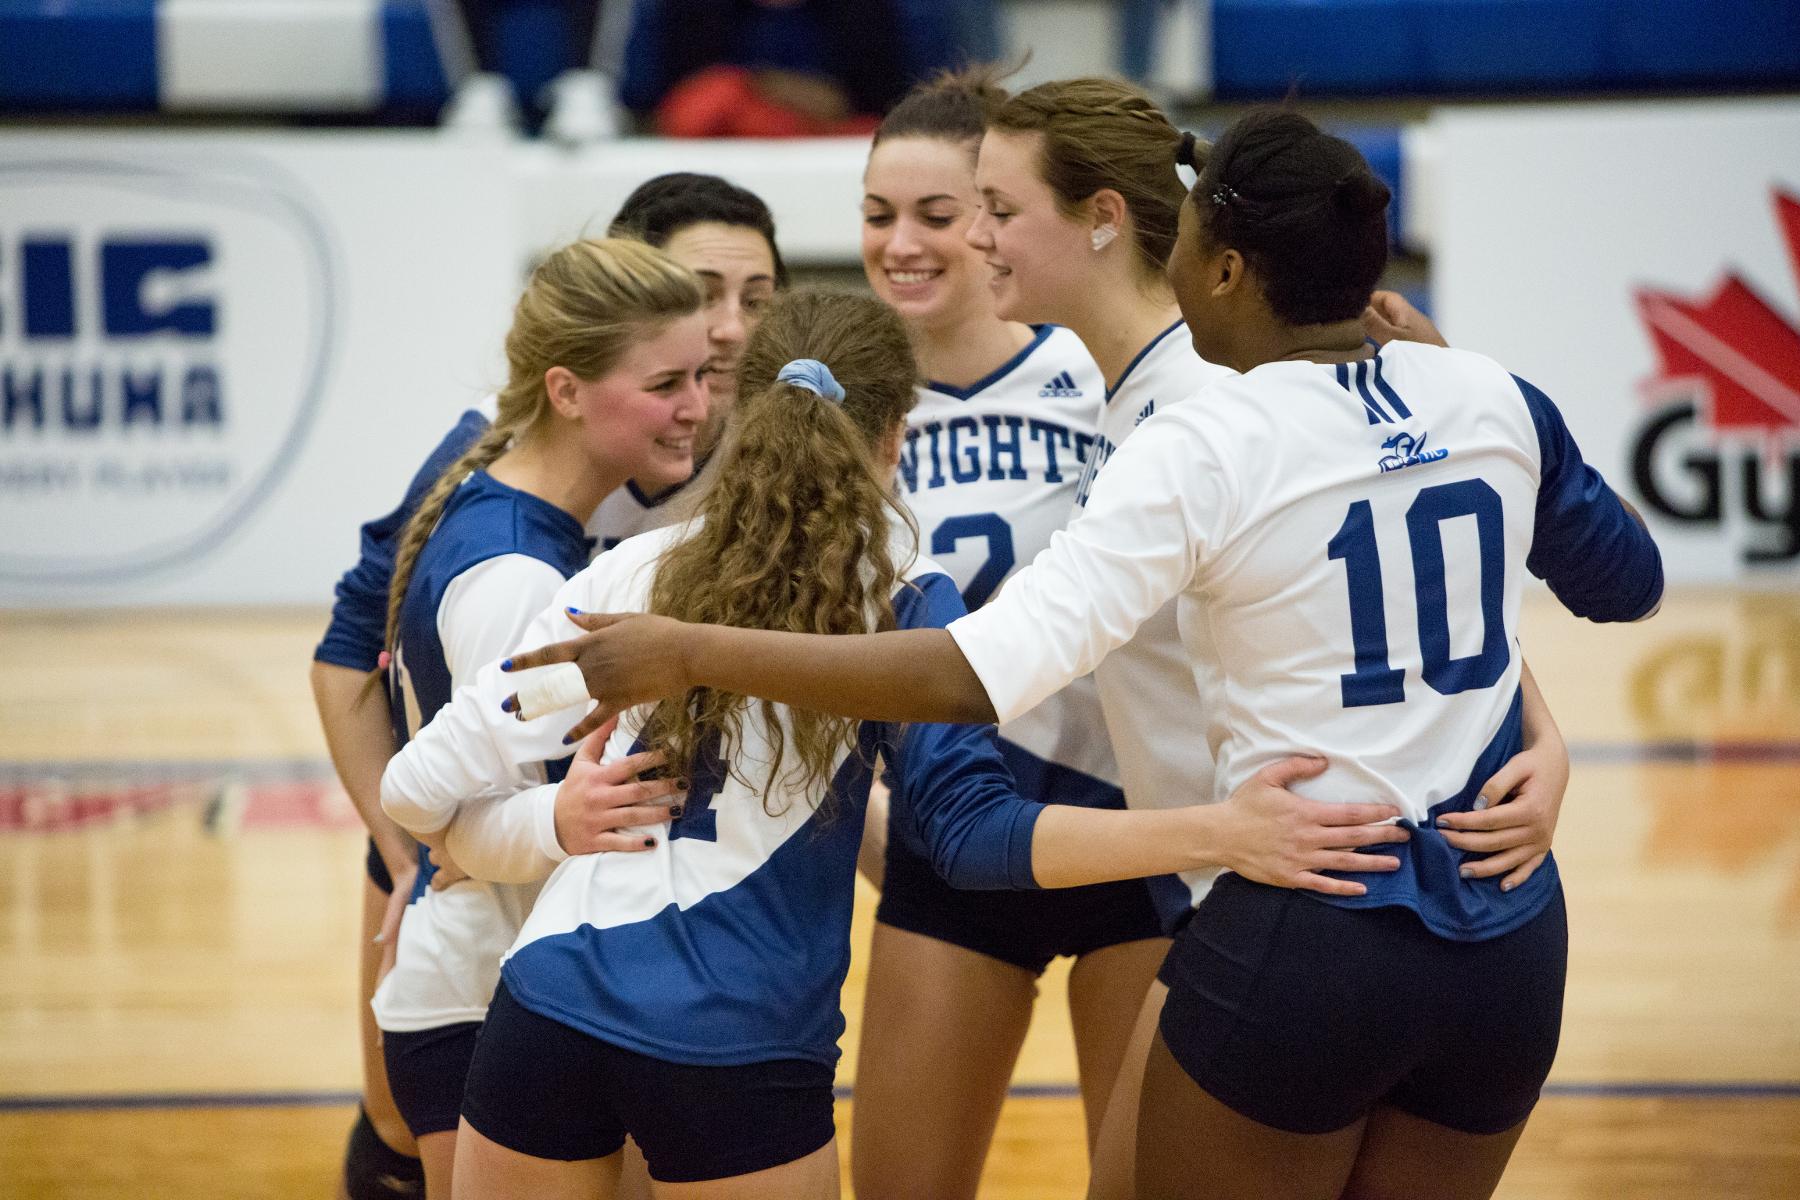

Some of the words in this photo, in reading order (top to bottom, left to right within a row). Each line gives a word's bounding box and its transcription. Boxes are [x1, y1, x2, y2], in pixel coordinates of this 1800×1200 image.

[0, 238, 217, 338] IC
[897, 414, 1095, 494] NIGHT
[1327, 478, 1510, 708] 10
